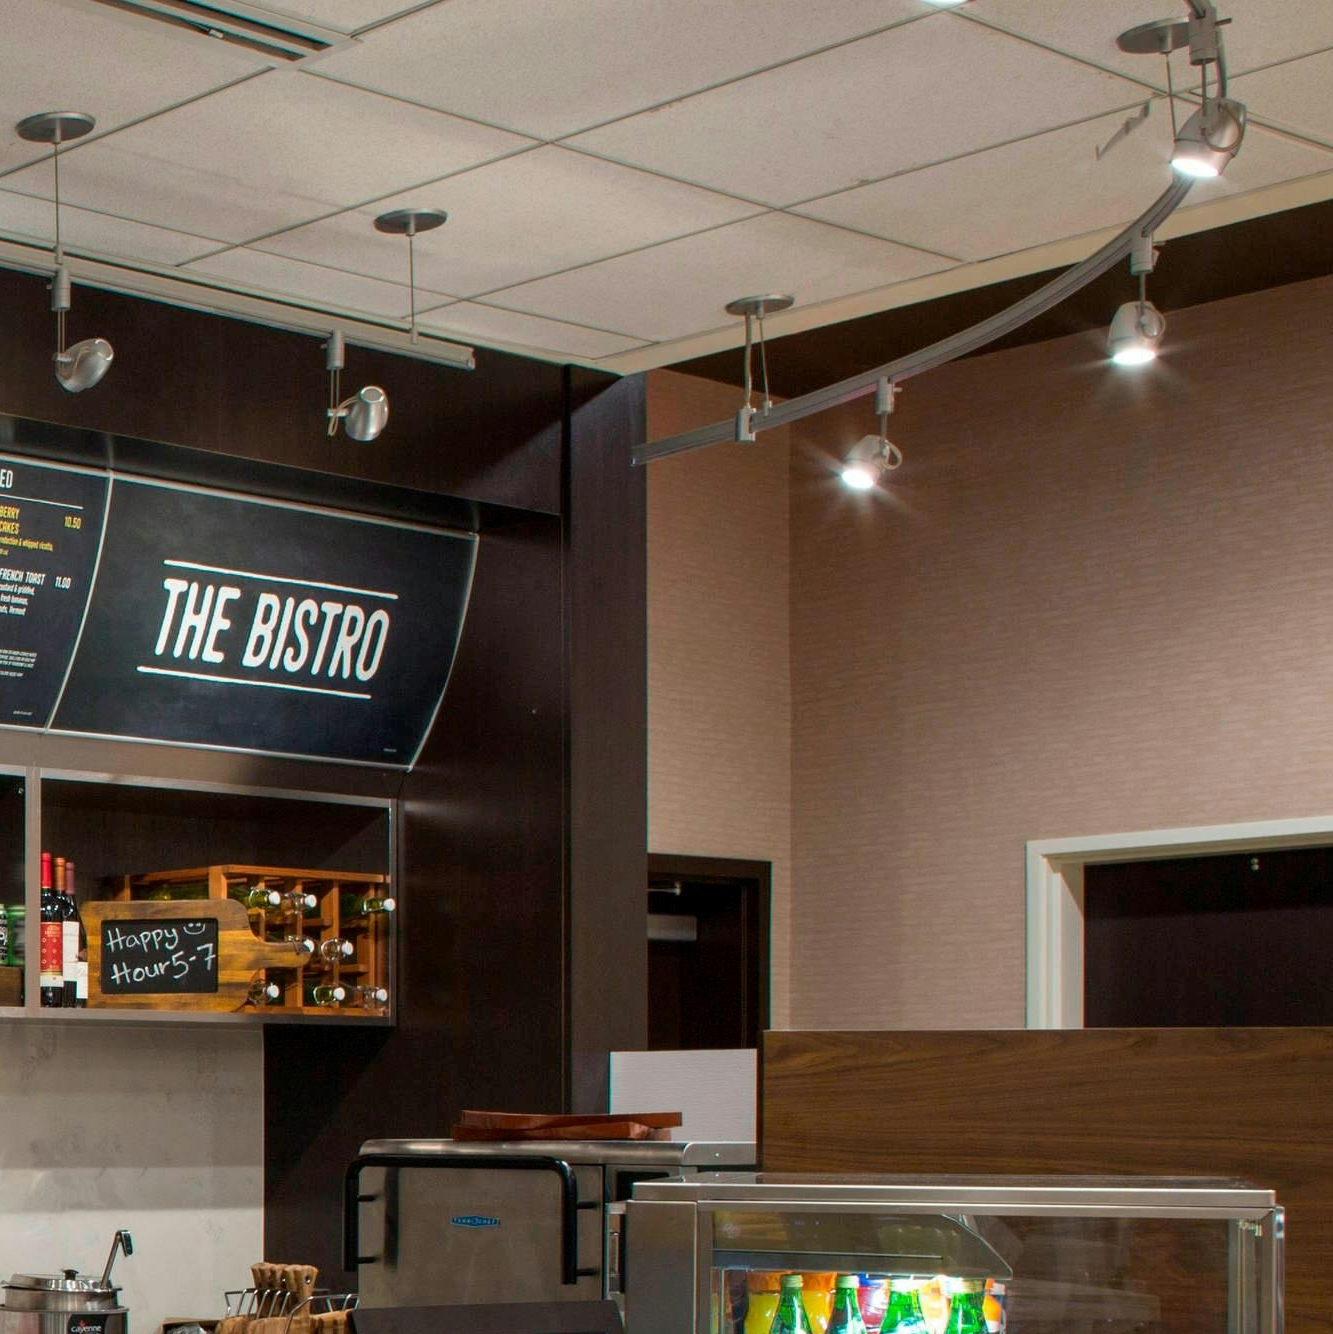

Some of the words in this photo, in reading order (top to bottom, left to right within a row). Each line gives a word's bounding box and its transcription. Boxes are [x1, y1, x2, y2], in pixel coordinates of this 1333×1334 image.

[65, 515, 81, 529] 10.50
[154, 578, 241, 663] THE
[242, 593, 390, 681] BISTRO
[106, 927, 178, 953] Happy
